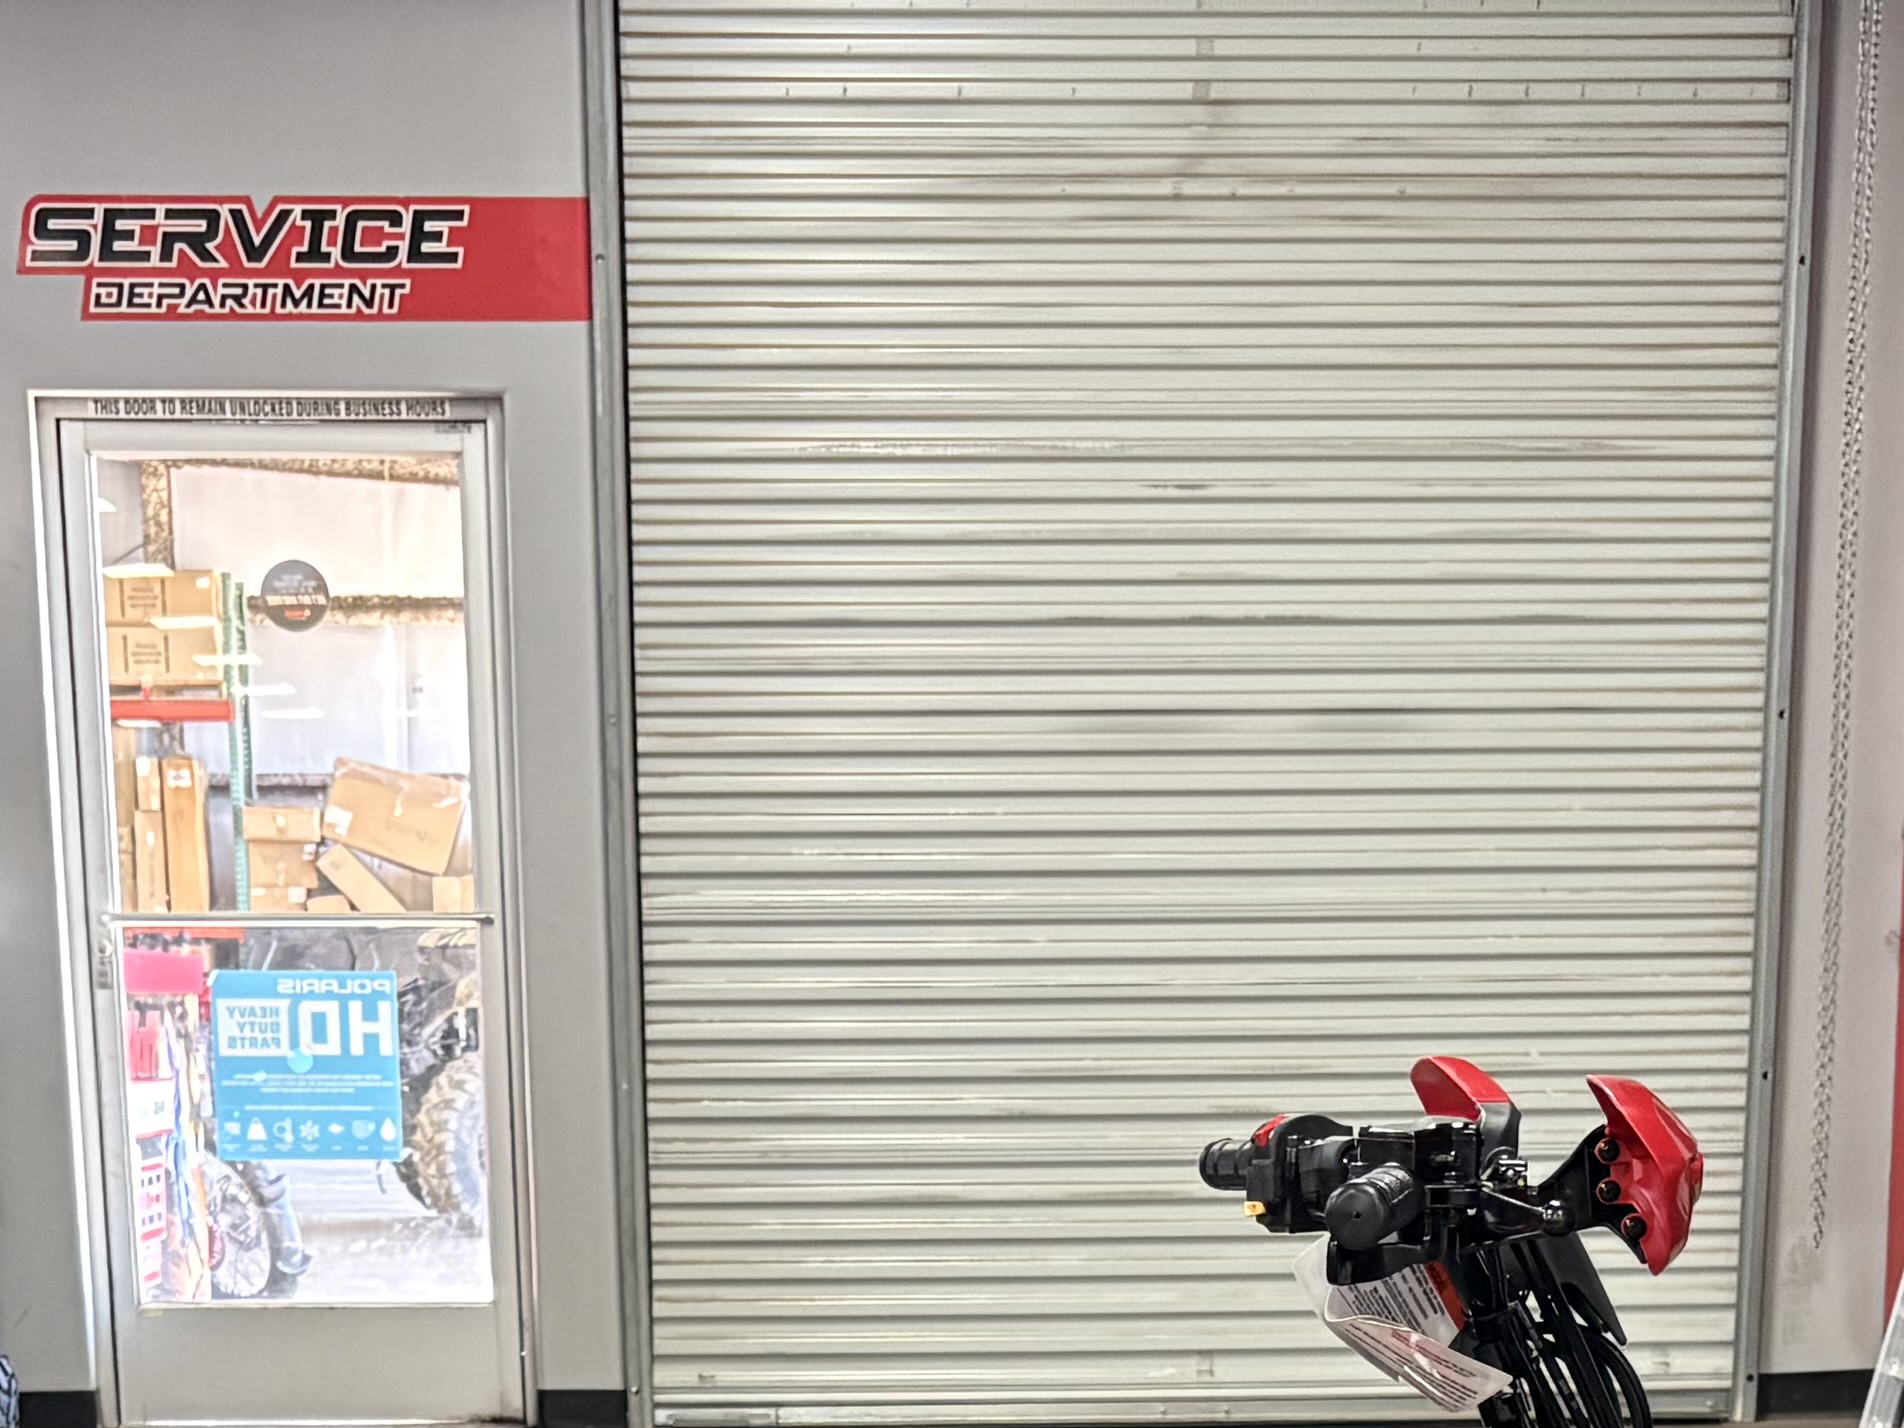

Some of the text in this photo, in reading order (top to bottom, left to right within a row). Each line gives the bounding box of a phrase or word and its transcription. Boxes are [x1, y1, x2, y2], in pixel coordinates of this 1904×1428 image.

[27, 204, 469, 268] SERVICE
[90, 278, 410, 314] DEPARTMENT
[95, 400, 447, 417] THIS DOOR TO REMAIN UNLOCKED DURING BUSINESS HOURS
